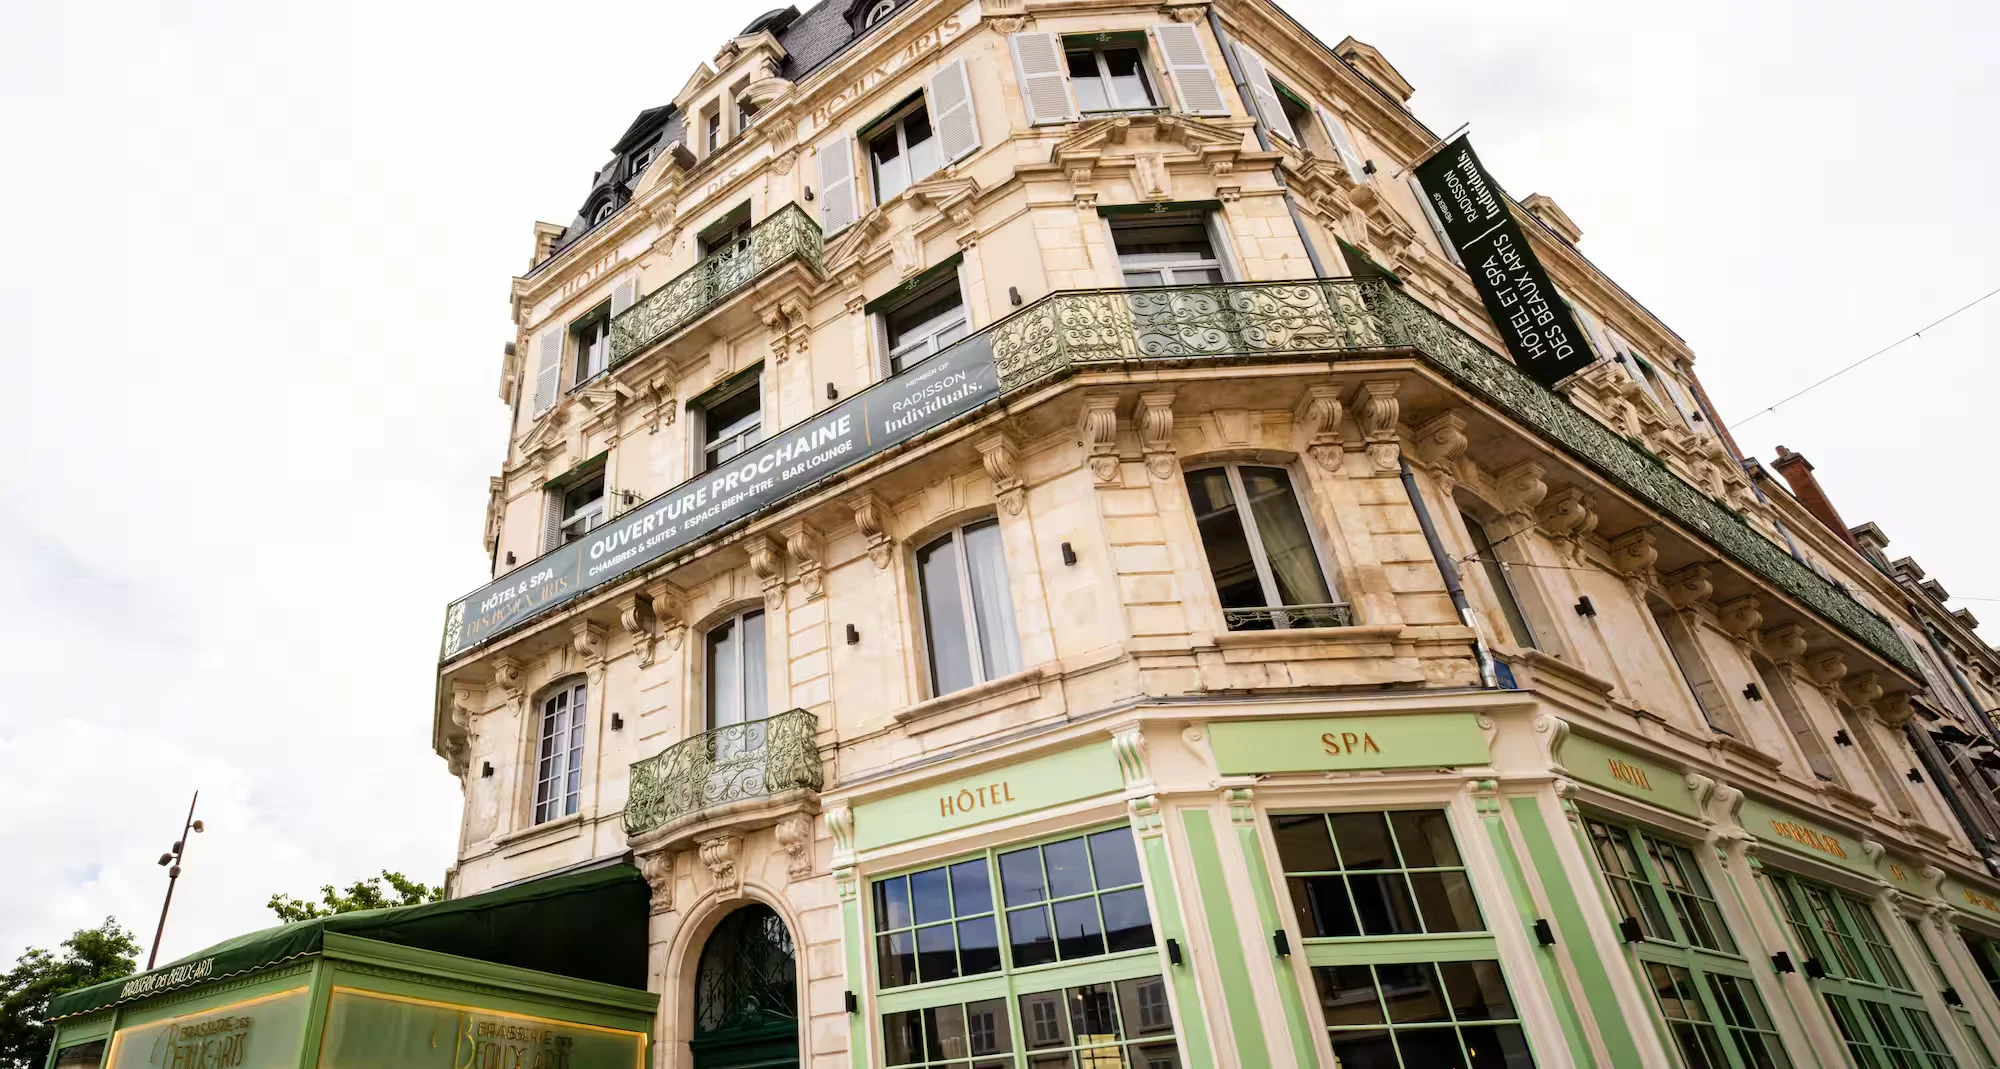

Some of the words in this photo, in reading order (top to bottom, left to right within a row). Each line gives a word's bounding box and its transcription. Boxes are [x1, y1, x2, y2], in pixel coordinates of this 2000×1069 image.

[899, 14, 962, 66] ARTS
[1443, 169, 1480, 223] RADISSON
[1456, 149, 1501, 221] Individuals.
[1481, 254, 1507, 287] SPA
[1493, 233, 1526, 272] ARTS
[1495, 286, 1519, 308] ET
[1513, 271, 1555, 327] BEAUX
[1510, 305, 1548, 360] HÔTEL
[1544, 324, 1575, 361] DES
[892, 369, 967, 414] RADISSON
[905, 367, 938, 389] MEMBER
[937, 361, 951, 372] OF
[884, 381, 984, 435] Individuals.
[588, 546, 638, 577] CHAMBRES
[646, 525, 678, 549] SUITES
[683, 502, 721, 530] ESPACE
[720, 477, 775, 511] BIEN-ÊTRE
[781, 462, 806, 482] BAR
[805, 439, 854, 470] LOUNGE
[589, 486, 707, 561] OUVERTURE
[711, 413, 852, 500] PROCHAINE
[480, 586, 517, 615] HÔTEL
[519, 580, 529, 595] &
[529, 567, 555, 589] SPA
[1321, 731, 1381, 756] SPA
[939, 781, 1016, 818] HÔTEL
